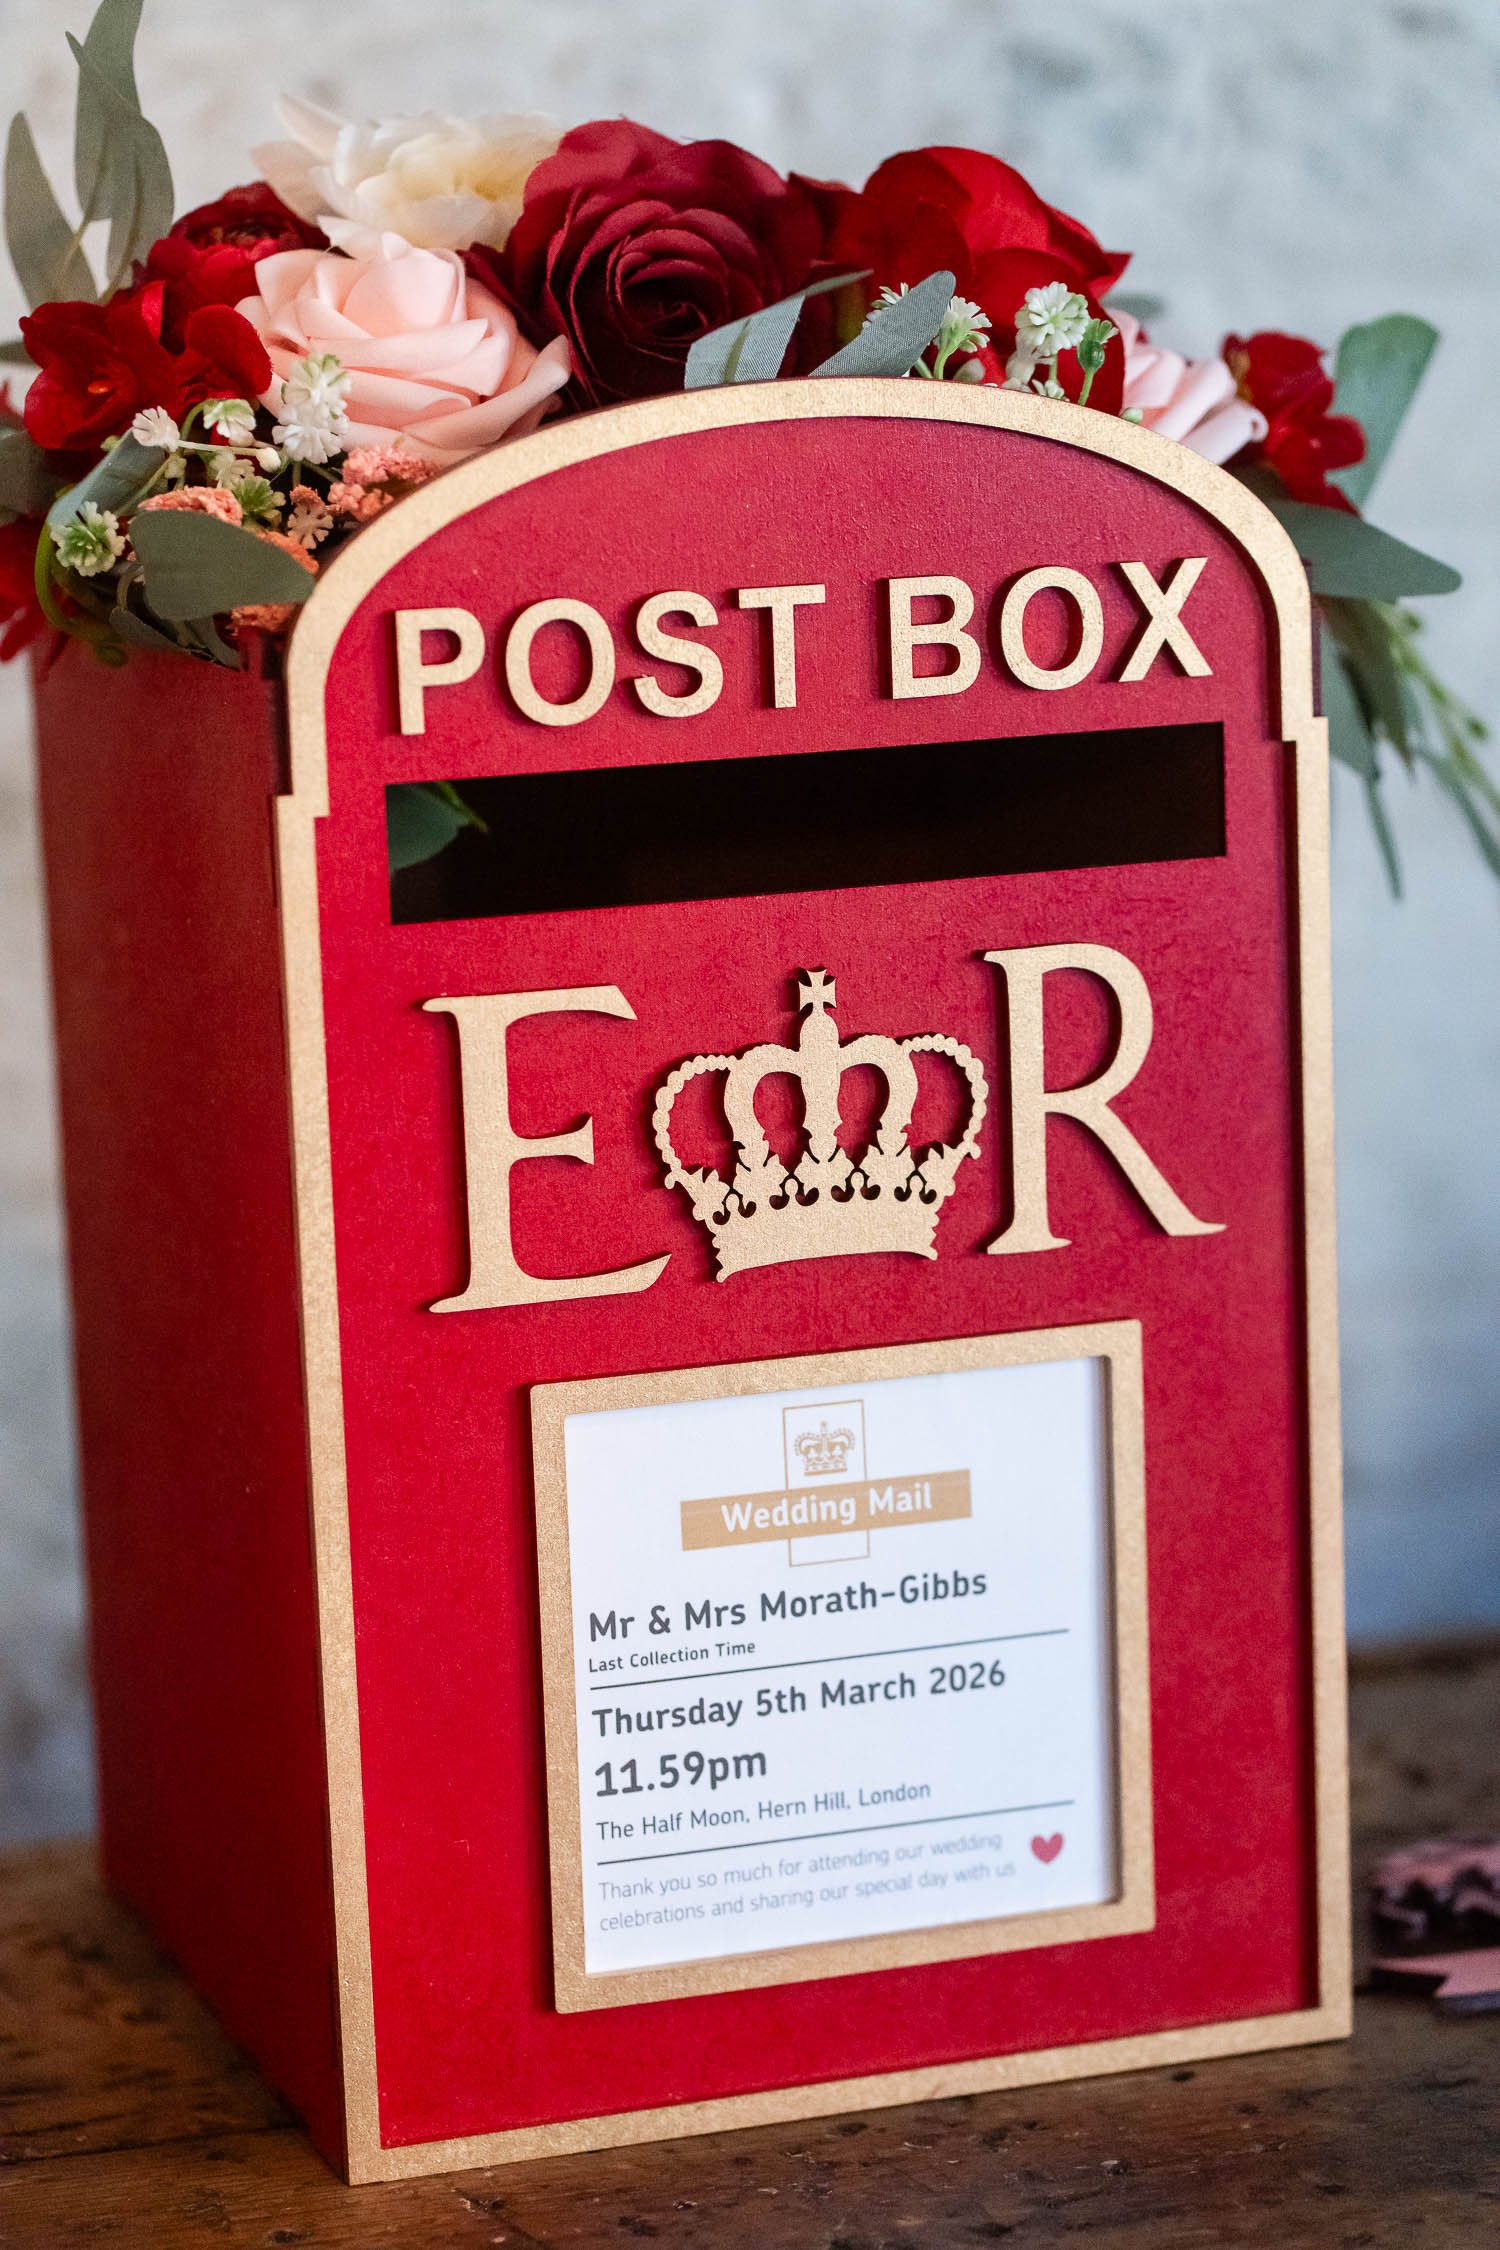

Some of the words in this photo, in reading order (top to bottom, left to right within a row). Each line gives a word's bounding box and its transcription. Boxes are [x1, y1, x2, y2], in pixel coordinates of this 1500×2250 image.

[394, 584, 827, 737] POST
[888, 556, 1214, 701] BOX
[422, 984, 673, 1314] E
[982, 941, 1228, 1256] R
[720, 1493, 857, 1533] Wedding
[868, 1481, 933, 1517] Mail
[589, 1609, 636, 1643] Mr
[648, 1604, 672, 1636] &
[684, 1599, 747, 1632] Mrs
[759, 1569, 988, 1623] Morath-Gibbs
[588, 1655, 625, 1674] Last
[629, 1646, 710, 1669] Collection
[714, 1641, 756, 1658] Time
[591, 1696, 744, 1738] Thursday
[755, 1685, 807, 1718] 5th
[820, 1671, 917, 1710] March
[928, 1658, 1007, 1696] 2026
[594, 1750, 768, 1798] 11.59pm
[594, 1820, 635, 1841] The
[642, 1811, 684, 1836] Half
[757, 1799, 807, 1820] Hern
[858, 1782, 931, 1807] London
[598, 1877, 654, 1901] Thank
[658, 1874, 692, 1896] you
[697, 1873, 718, 1888] so
[723, 1861, 773, 1885] much
[777, 1857, 803, 1876] for
[808, 1848, 891, 1873] attending
[895, 1844, 925, 1862] our
[929, 1832, 1003, 1857] wedding
[599, 1905, 706, 1932] celebrations
[711, 1897, 745, 1917] and
[750, 1889, 814, 1912] sharing
[819, 1885, 850, 1903] our
[855, 1872, 913, 1898] special
[917, 1870, 949, 1890] day
[953, 1862, 991, 1883] with
[995, 1860, 1017, 1878] us
